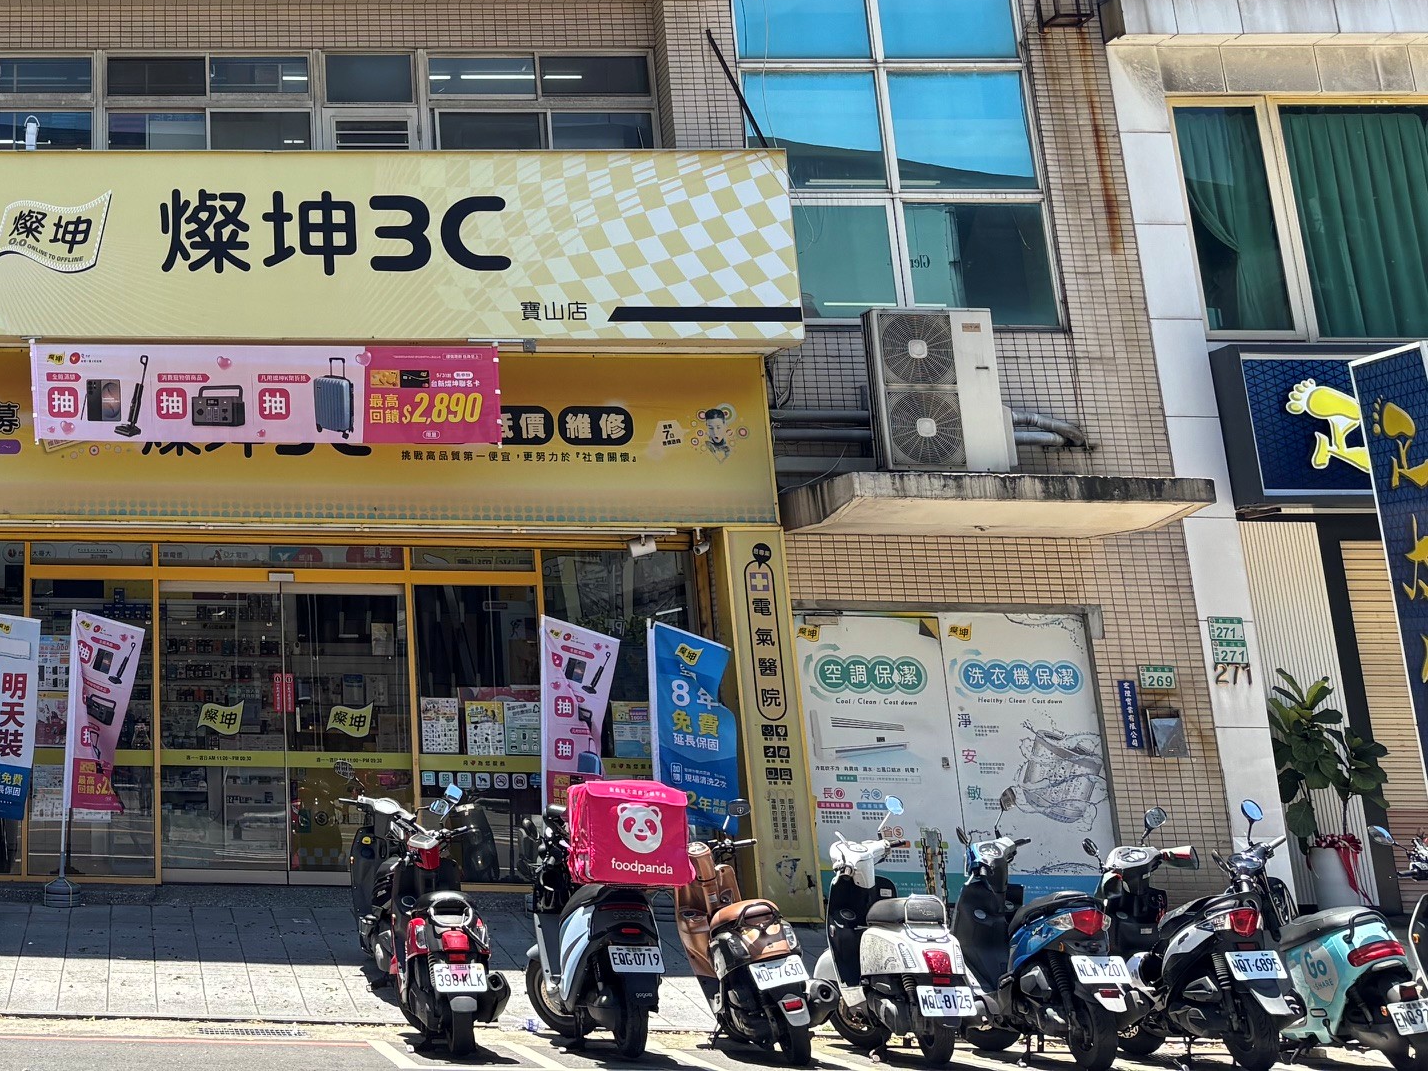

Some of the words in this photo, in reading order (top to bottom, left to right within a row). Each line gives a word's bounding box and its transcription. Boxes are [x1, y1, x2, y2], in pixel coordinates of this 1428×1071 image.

[8, 209, 93, 254] 燦坤
[160, 188, 512, 276] 燦坤3C
[26, 243, 48, 258] ONLINE
[56, 255, 84, 263] OFFLINE
[520, 300, 588, 323] 寶山店
[51, 391, 75, 414] 抽
[160, 391, 183, 415] 抽
[262, 392, 286, 415] 抽
[369, 393, 399, 408] 最高
[402, 393, 483, 425] $2,890
[369, 409, 401, 424] 回饋
[565, 412, 625, 439] 維修
[1216, 627, 1236, 639] 271
[752, 598, 782, 708] 電氣醫院
[1221, 650, 1245, 662] 271
[824, 664, 918, 685] 空調保潔
[968, 667, 1075, 686] 洗衣機保潔
[1148, 675, 1173, 687] 269
[1213, 664, 1253, 685] 271
[672, 679, 719, 710] 8年
[835, 697, 851, 705] Cool
[557, 698, 572, 715] 抽
[203, 708, 237, 729] 燦坤
[332, 710, 367, 732] 燦坤
[672, 708, 719, 737] 免費
[957, 713, 972, 728] 淨
[557, 741, 572, 757] 抽
[673, 732, 719, 752] 延長保固
[962, 749, 977, 764] 安
[823, 787, 834, 800] 長
[860, 788, 871, 800] 冷
[967, 785, 983, 801] 敏
[611, 857, 674, 875] foodpanda
[611, 952, 660, 967] EQG-0719
[1304, 948, 1328, 980] Go
[437, 969, 485, 987] 398-KLK
[755, 962, 804, 984] MDF-7630
[1315, 980, 1334, 990] SHARE
